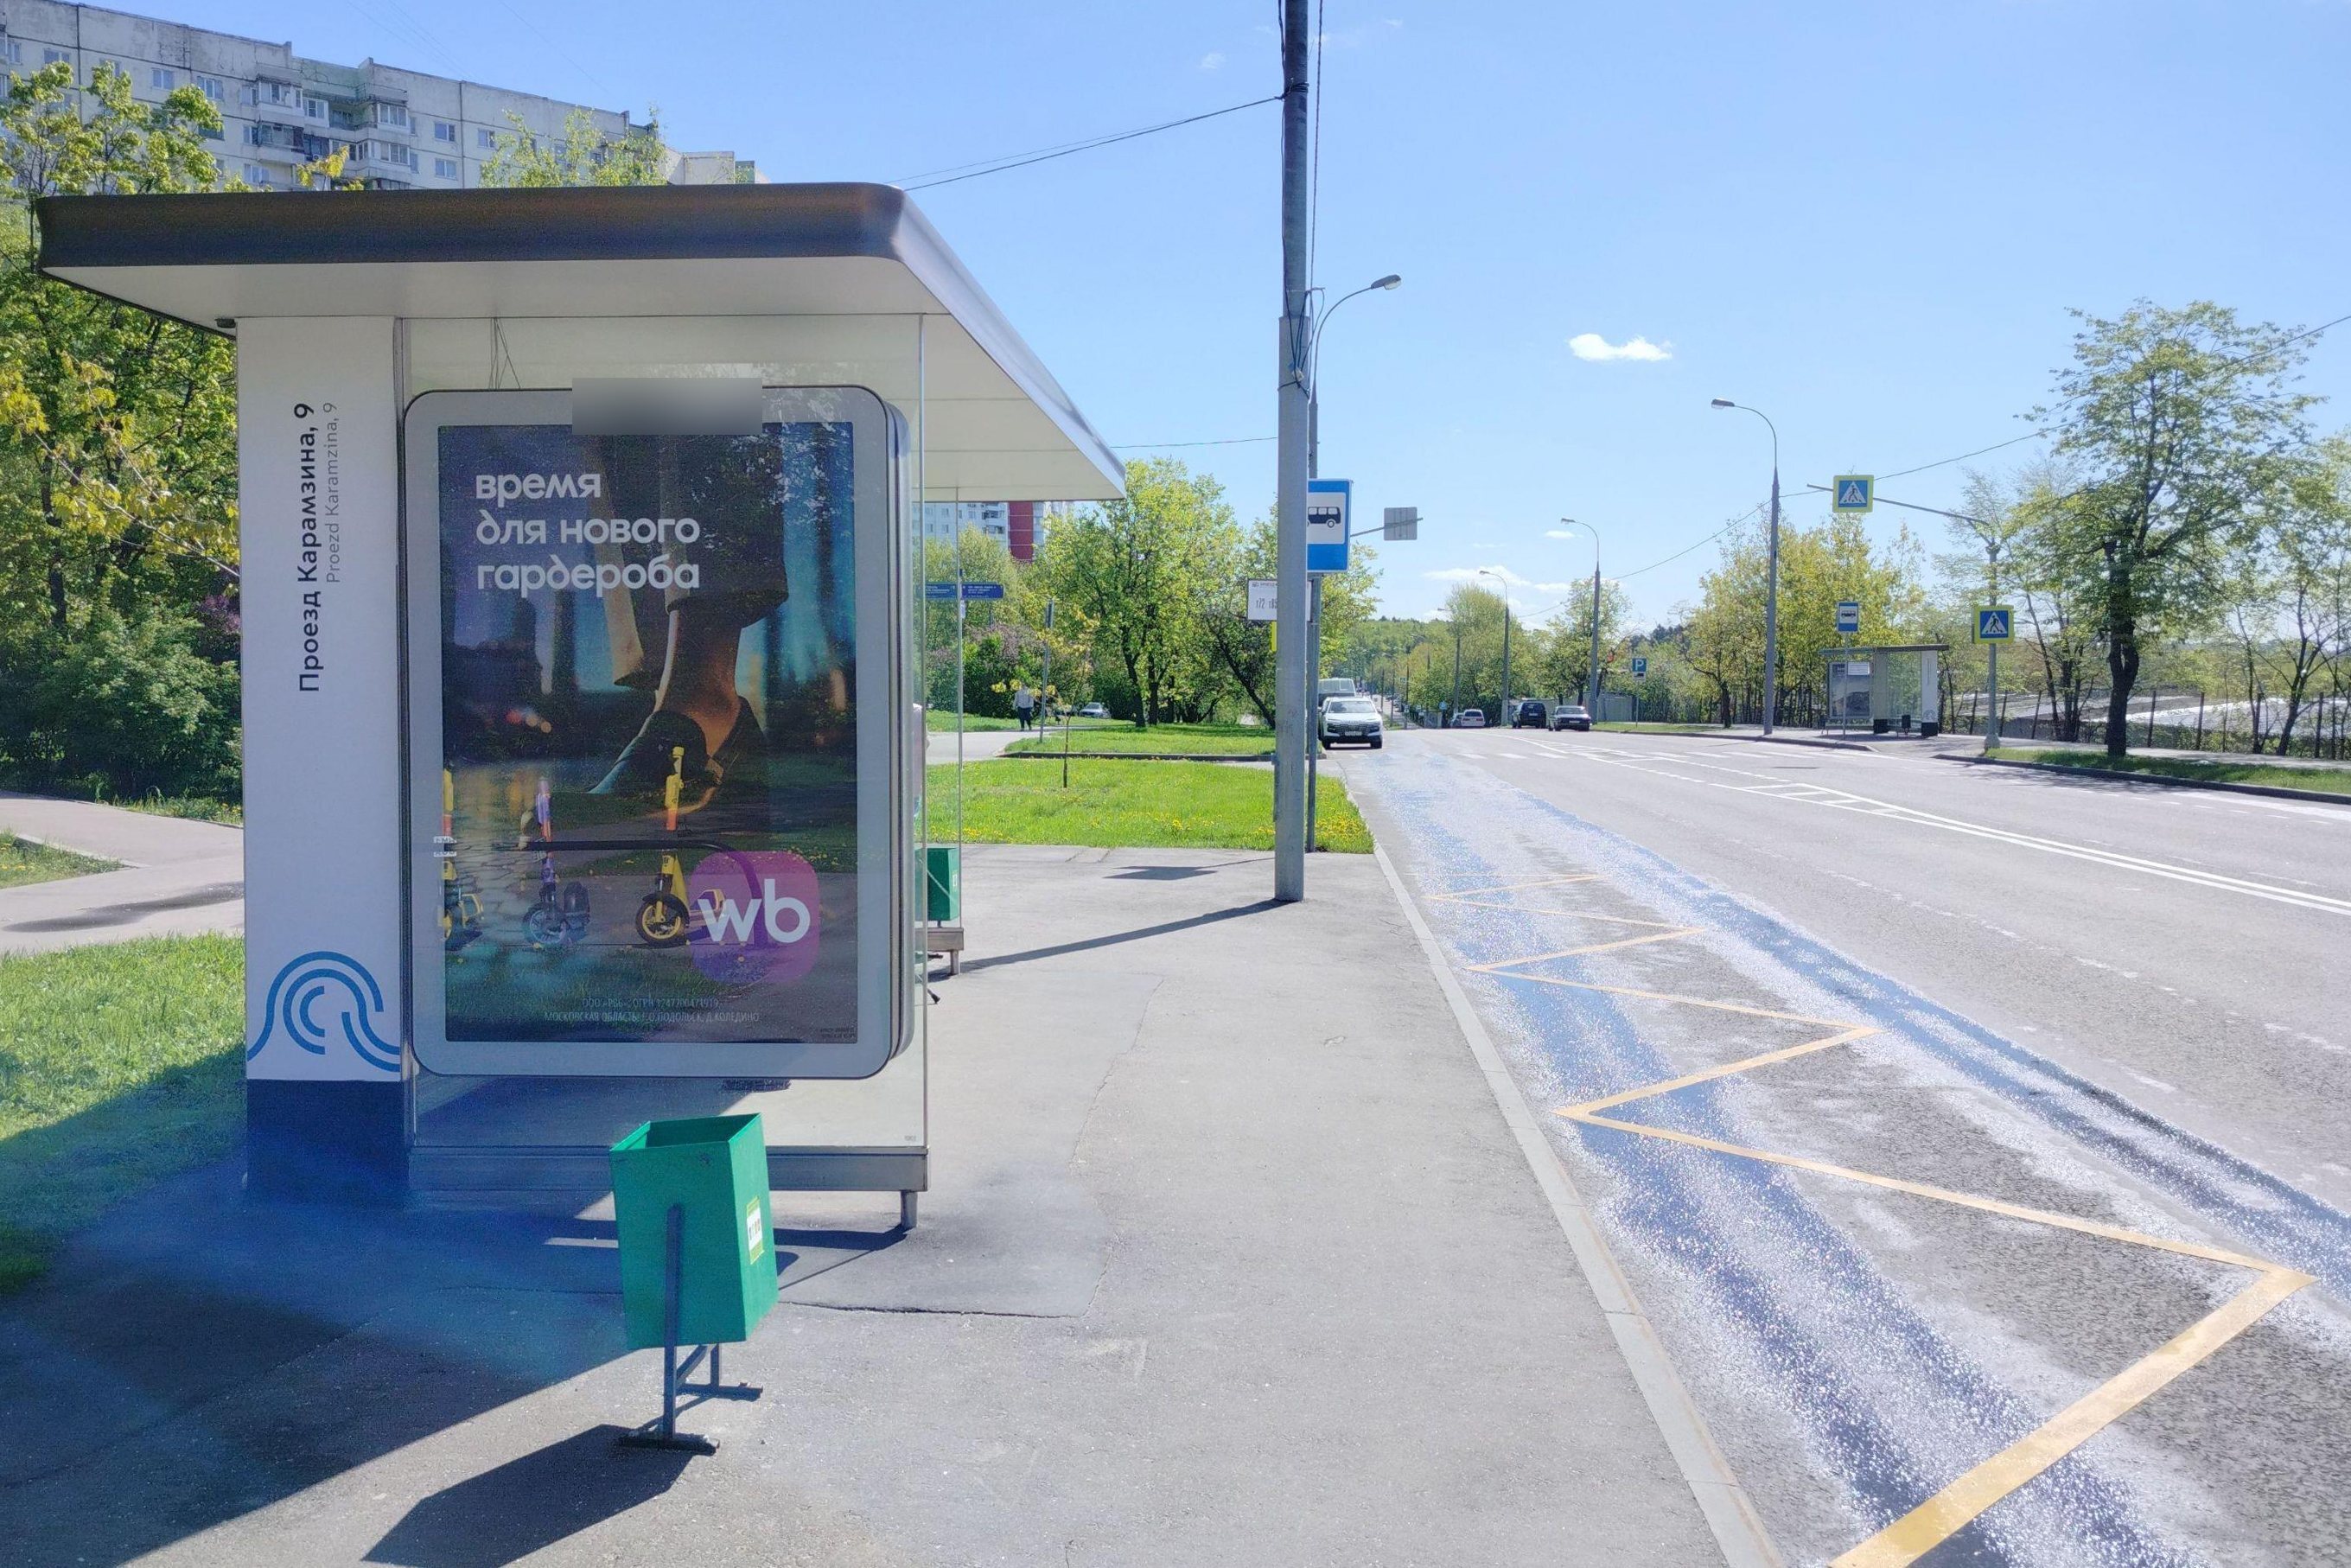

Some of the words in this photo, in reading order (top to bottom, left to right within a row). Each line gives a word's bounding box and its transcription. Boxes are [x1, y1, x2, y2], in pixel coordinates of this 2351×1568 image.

[293, 403, 315, 419] 9
[322, 402, 337, 413] 9
[325, 418, 340, 516] Karamzina,
[475, 473, 602, 508] время
[297, 427, 322, 583] Карамзина,
[476, 509, 546, 545] для
[560, 518, 701, 544] нового
[325, 524, 341, 583] Proezd
[477, 553, 700, 598] гардероба
[299, 591, 325, 692] Проезд
[698, 878, 811, 943] wb
